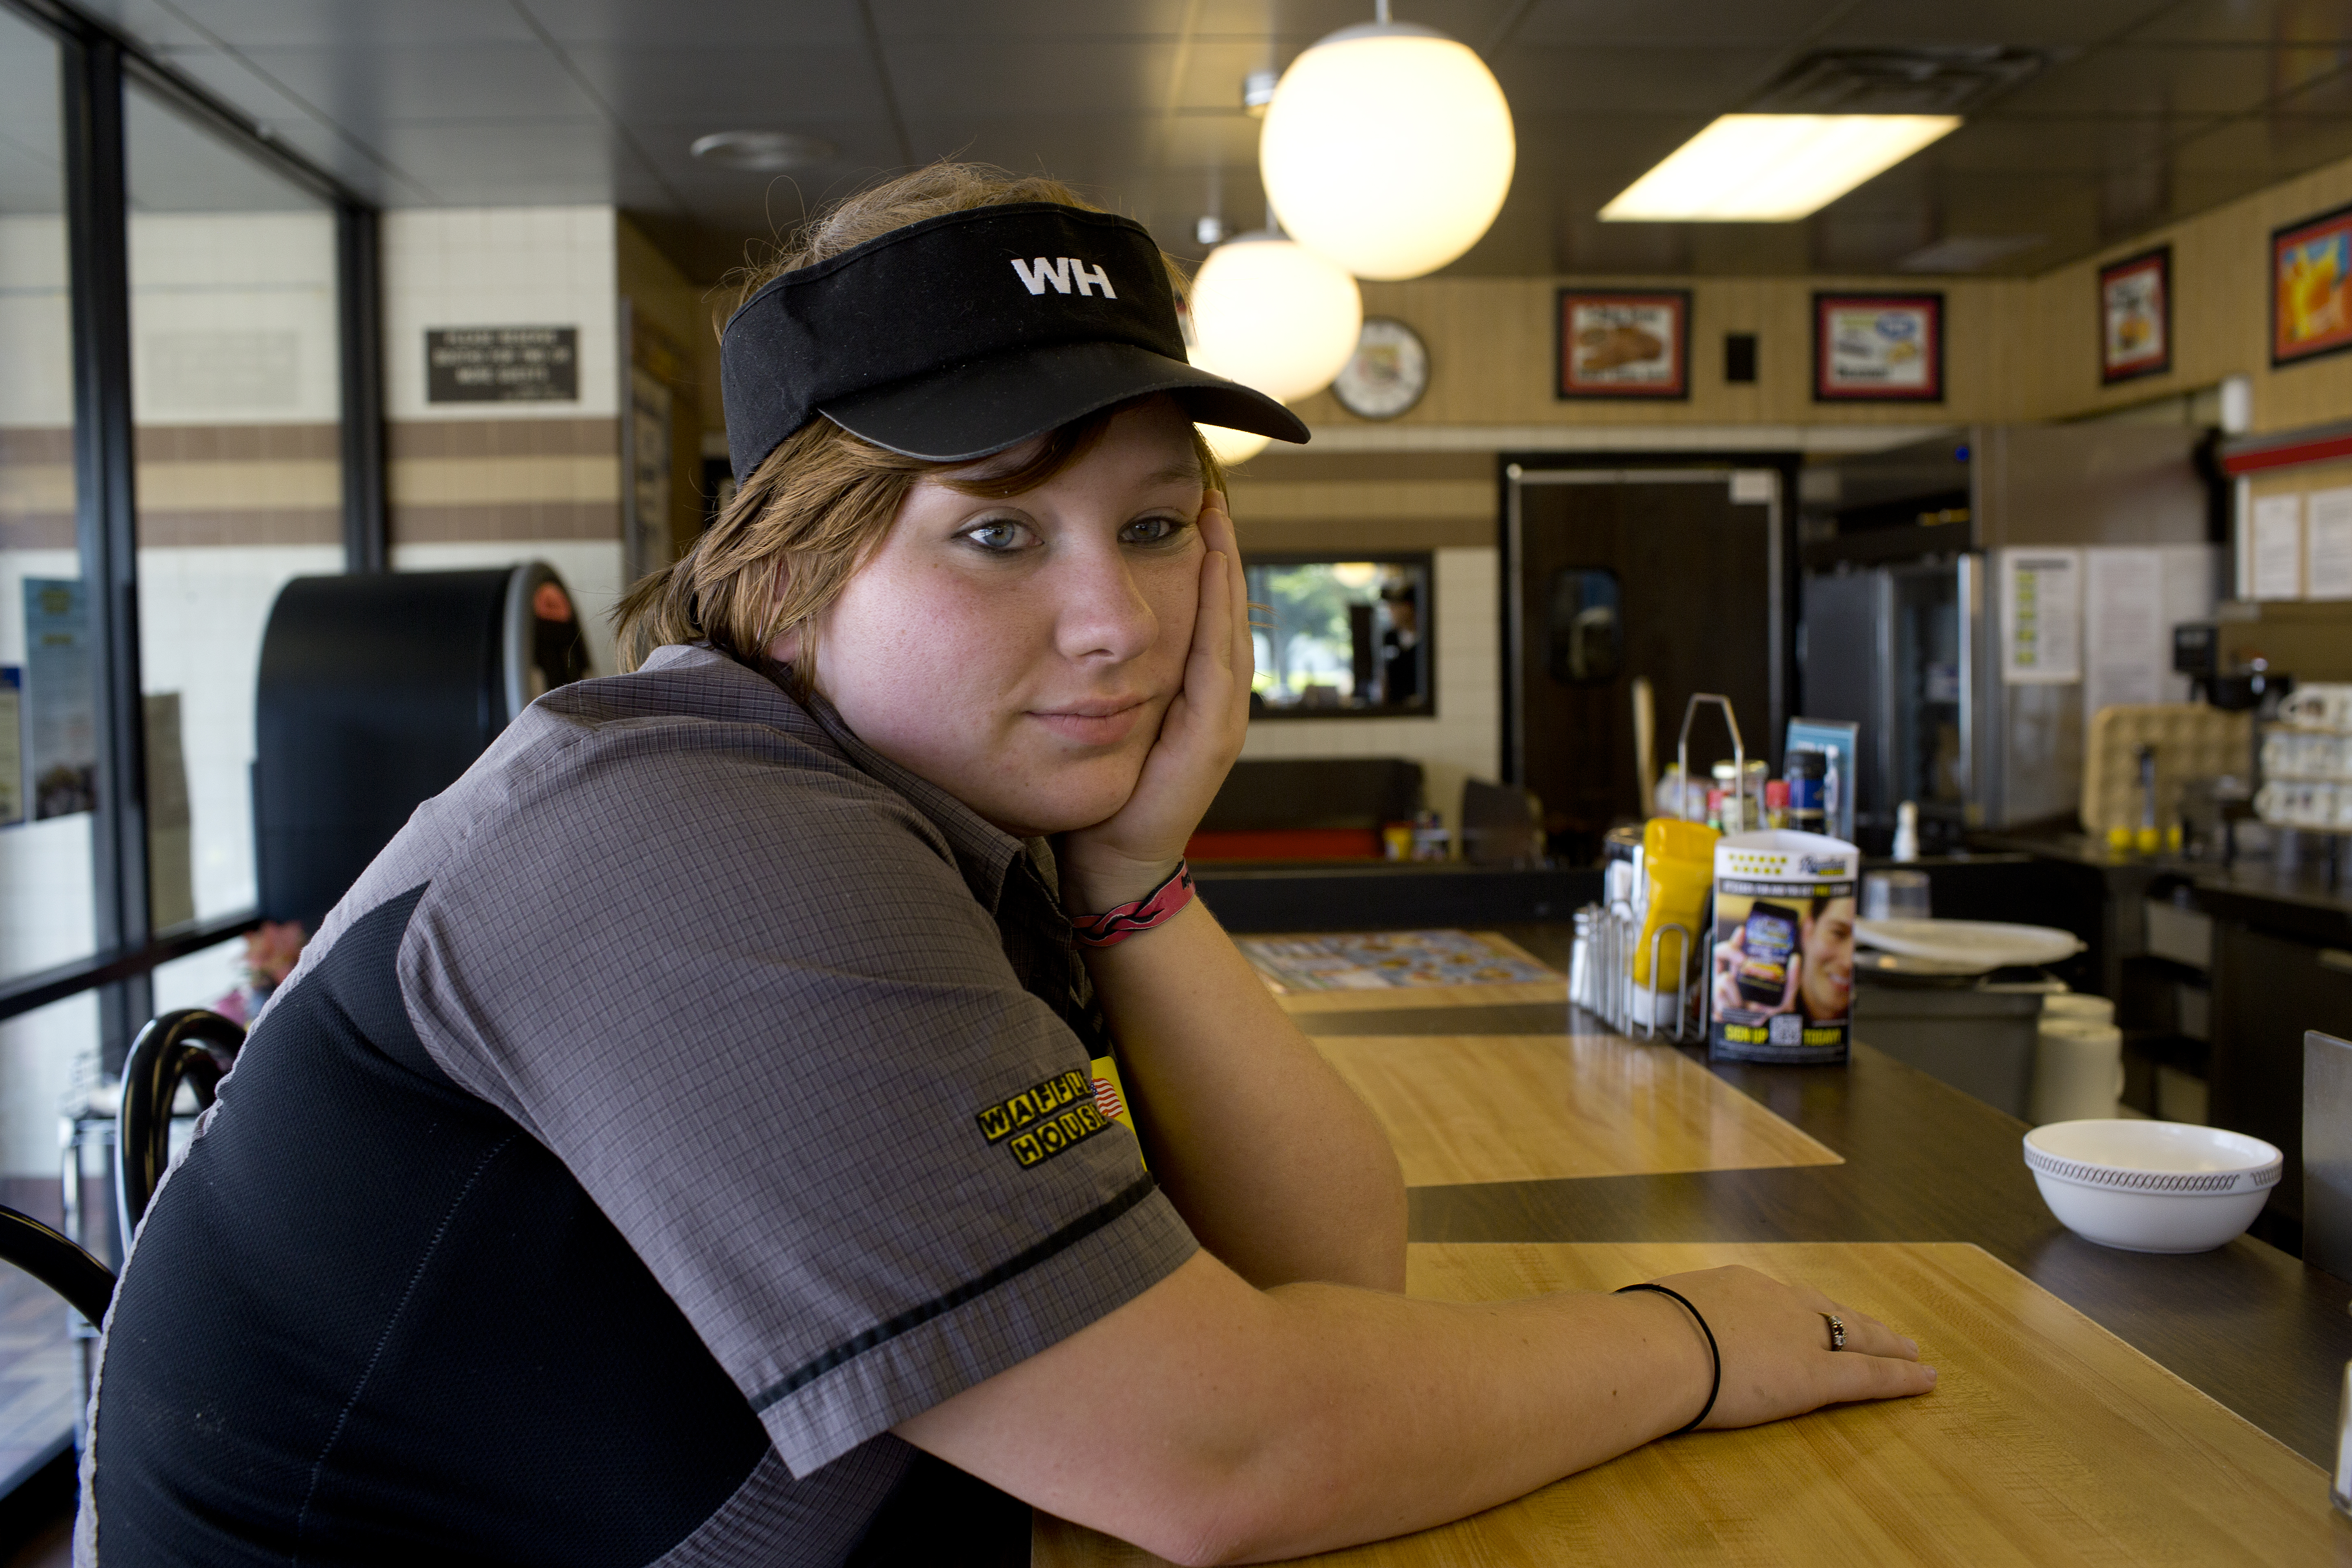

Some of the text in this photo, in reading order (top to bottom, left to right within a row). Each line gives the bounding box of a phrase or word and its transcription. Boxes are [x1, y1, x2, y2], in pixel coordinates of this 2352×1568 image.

[1010, 257, 1118, 299] WH
[1753, 1027, 1769, 1045] UP
[978, 1070, 1093, 1143] WAFFL
[1009, 1102, 1110, 1167] HOUS
